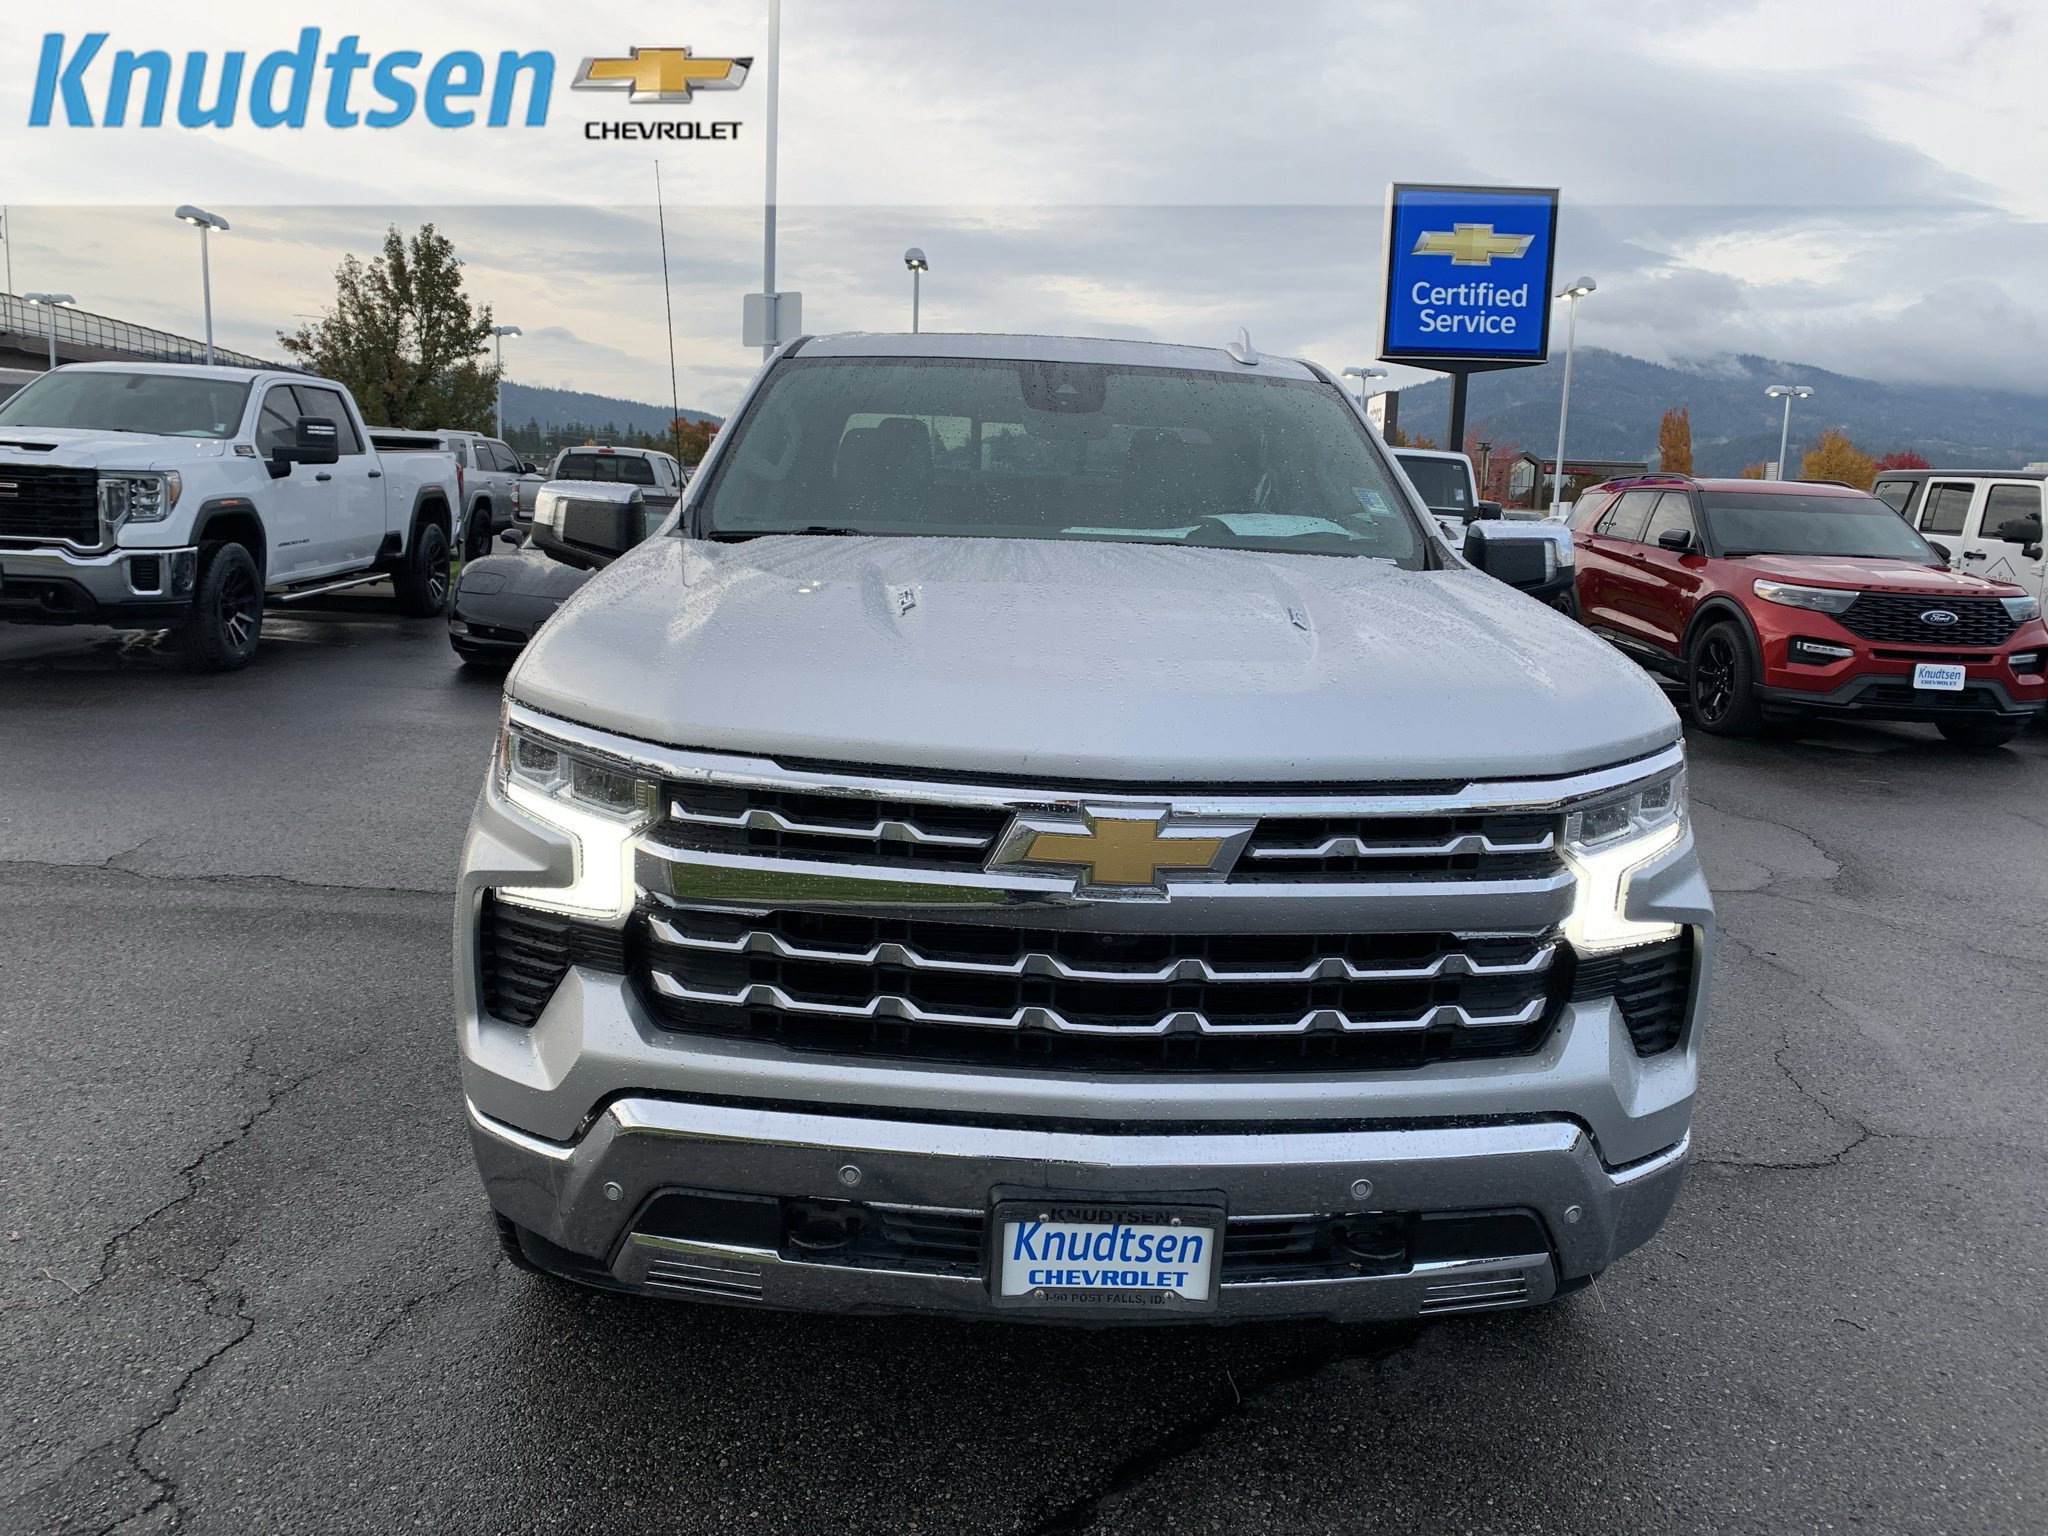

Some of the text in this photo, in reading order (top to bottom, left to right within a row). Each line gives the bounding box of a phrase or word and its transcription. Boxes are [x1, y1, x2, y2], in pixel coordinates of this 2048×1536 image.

[1412, 281, 1528, 307] Certified
[1419, 309, 1516, 334] Service
[1930, 613, 1951, 622] Ford
[1918, 667, 1961, 680] Knudtsen
[1051, 1208, 1170, 1224] KNUDTSEN
[1013, 1221, 1203, 1263] Knudtsen
[1028, 1269, 1189, 1287] CHEVROLET
[1071, 1293, 1104, 1303] POST
